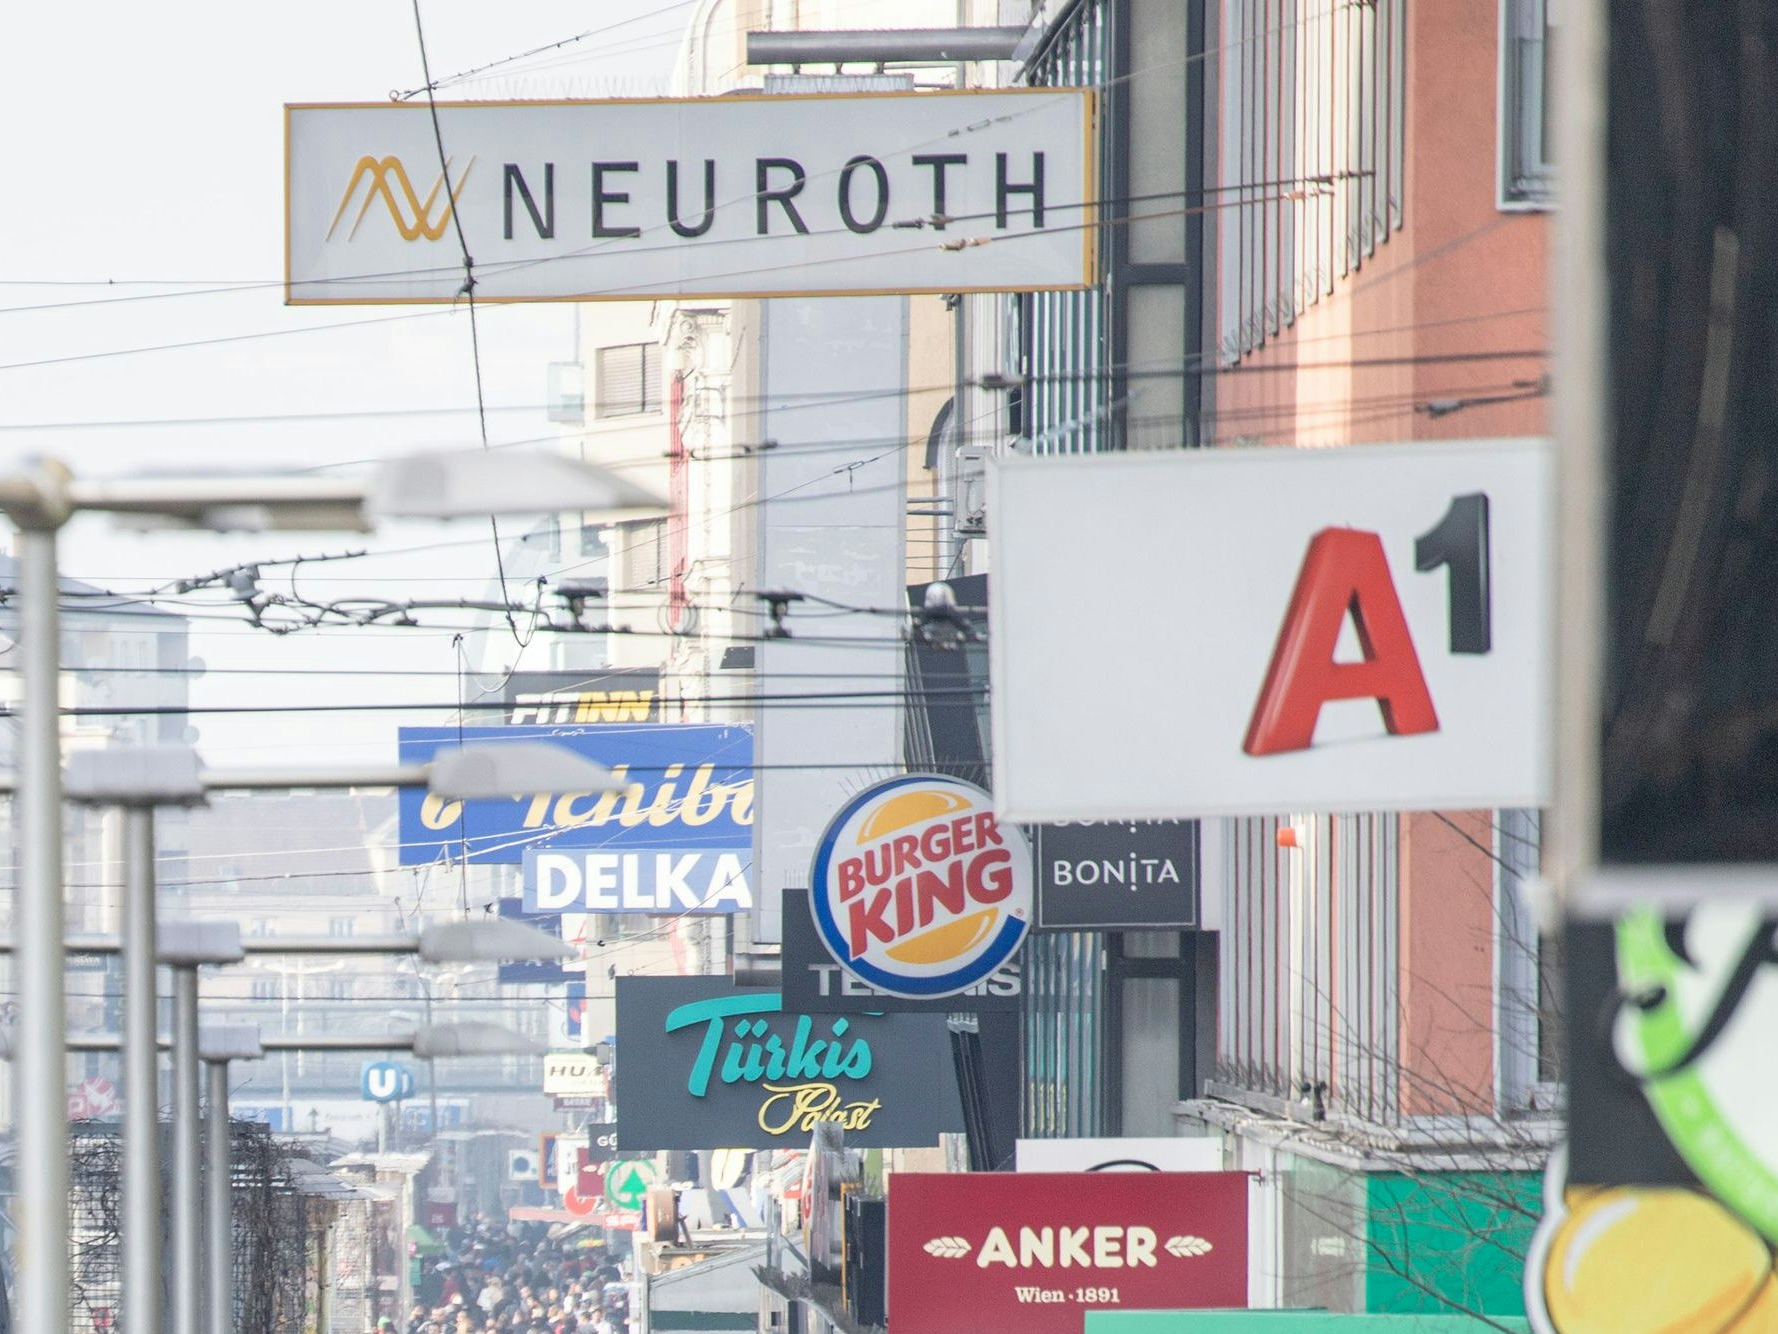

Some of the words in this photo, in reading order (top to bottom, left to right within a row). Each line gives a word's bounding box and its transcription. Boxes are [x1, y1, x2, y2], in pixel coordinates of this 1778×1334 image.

[502, 151, 1046, 240] NEUROTH
[1242, 491, 1492, 757] A1
[537, 853, 753, 910] DELKA
[837, 811, 1004, 903] BURGER
[848, 848, 1014, 961] KING
[808, 963, 1022, 997] TEIS
[665, 992, 874, 1097] Türkis
[368, 1068, 398, 1098] U
[757, 1082, 883, 1136] Palast
[976, 1226, 1159, 1268] ANKER
